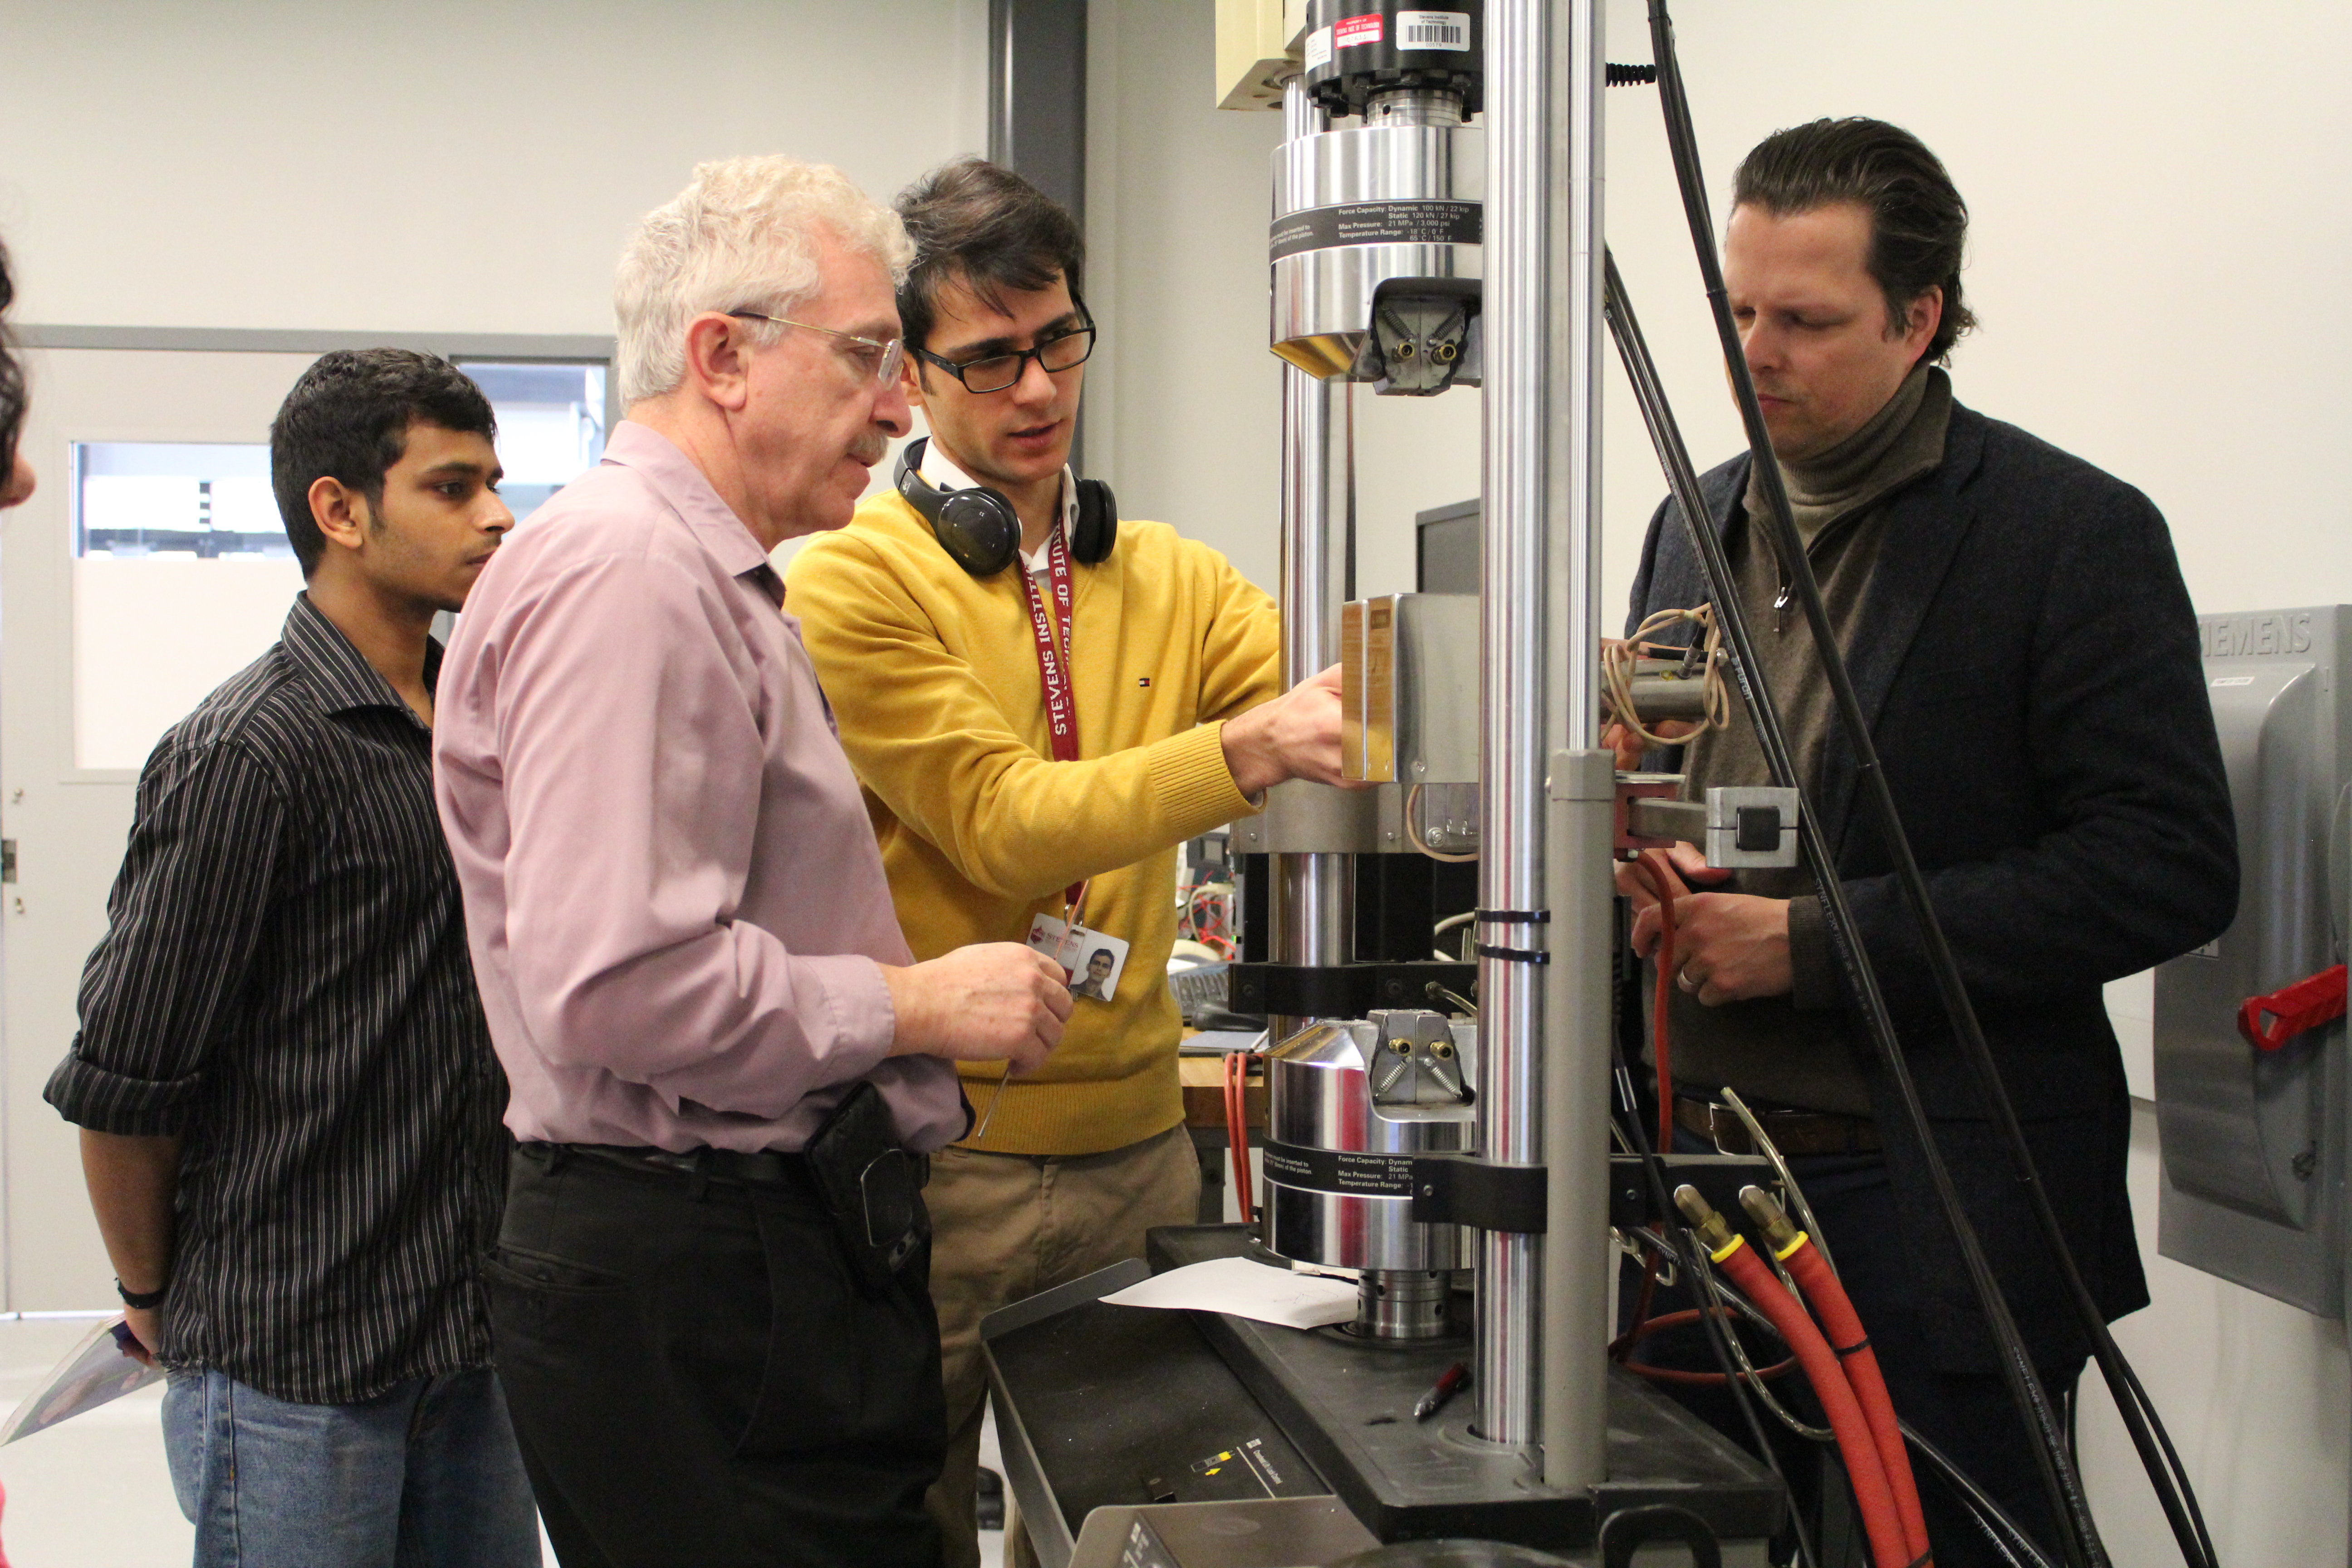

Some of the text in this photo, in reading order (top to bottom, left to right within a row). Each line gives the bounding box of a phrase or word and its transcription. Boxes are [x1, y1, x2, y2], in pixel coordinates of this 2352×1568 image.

[1361, 21, 1380, 30] TECHNOLOGY
[1357, 206, 1387, 214] Capacity:
[1338, 230, 1379, 239] Temperature
[1057, 583, 1069, 607] OF
[2198, 614, 2312, 657] IEMENS
[1042, 650, 1067, 735] STEVENS
[1046, 932, 1078, 948] STEENS
[1357, 1157, 1387, 1166] Capacity:
[1338, 1179, 1379, 1187] Temperature
